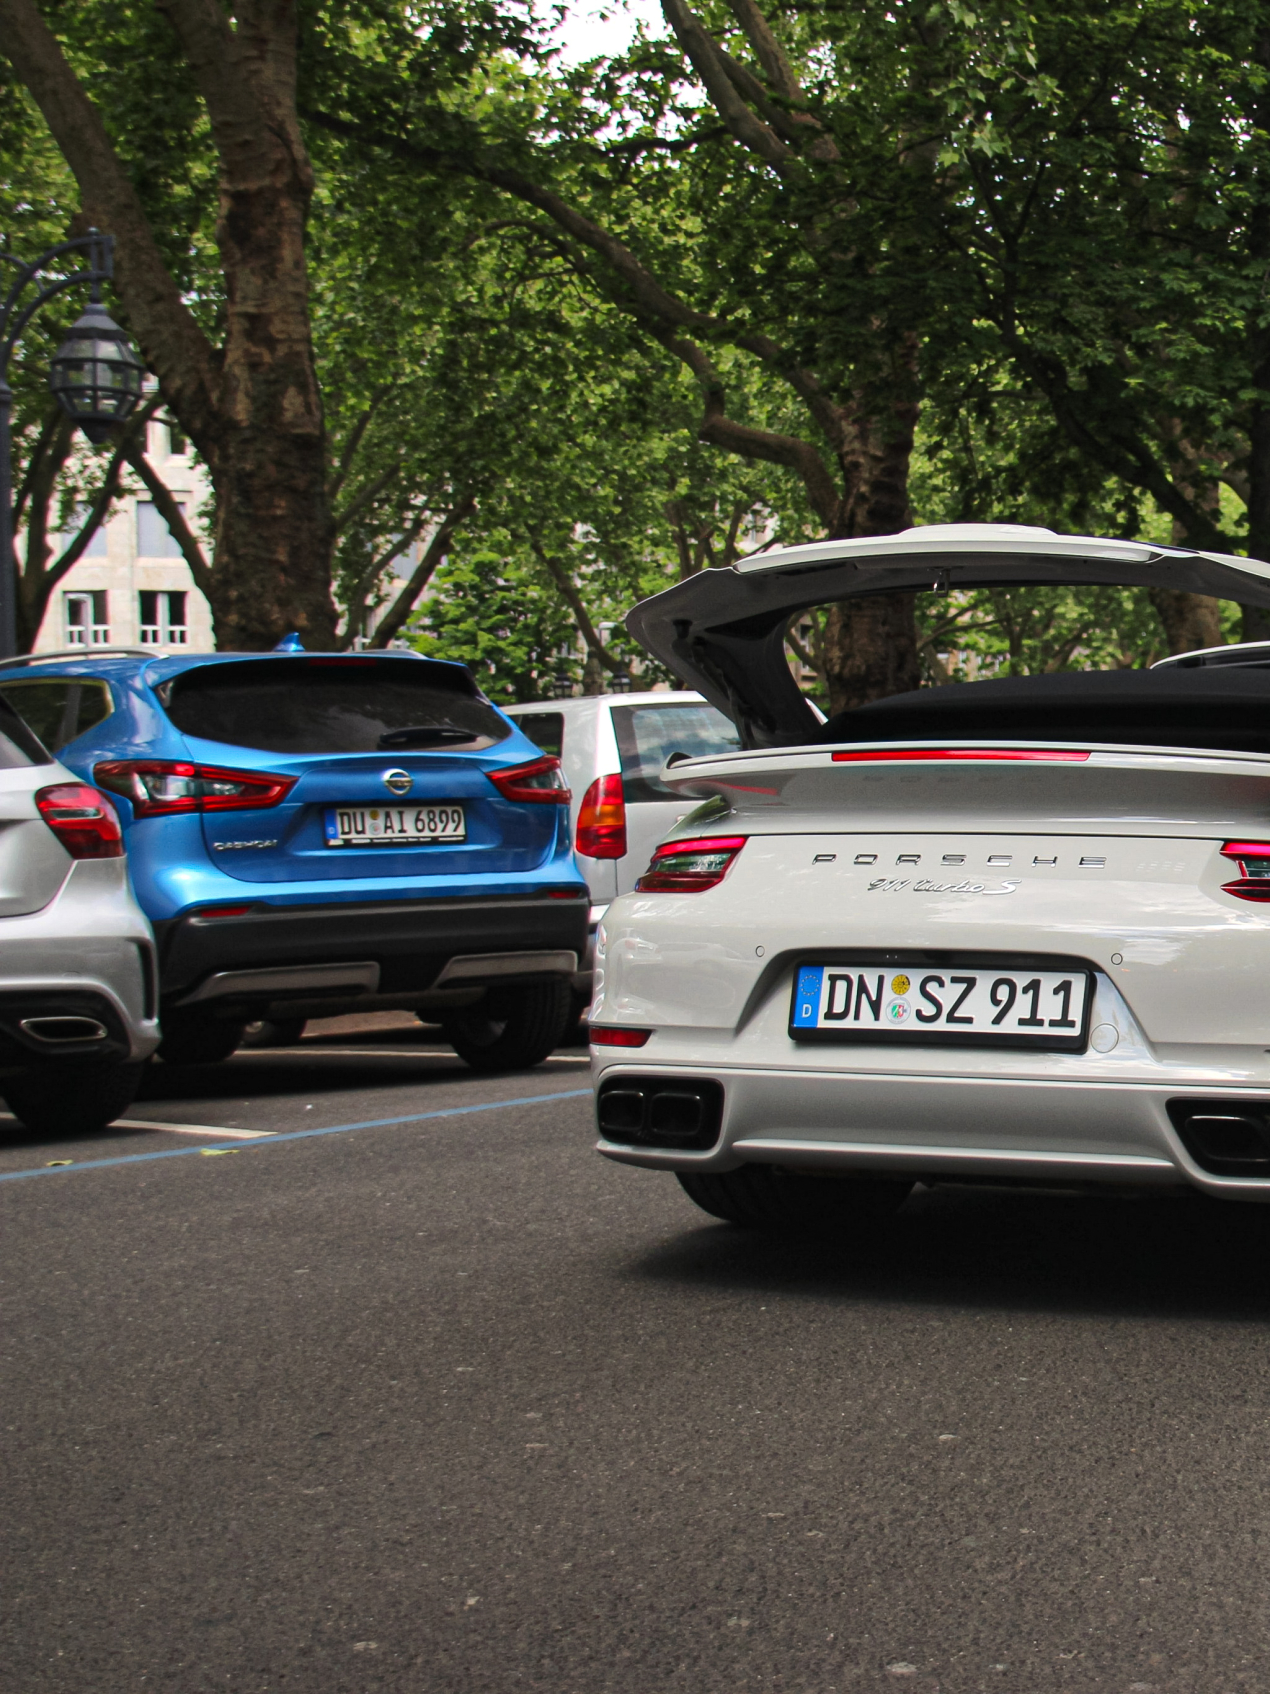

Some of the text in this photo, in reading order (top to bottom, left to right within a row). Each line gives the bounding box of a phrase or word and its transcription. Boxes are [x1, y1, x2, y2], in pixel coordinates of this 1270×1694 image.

[339, 809, 463, 836] DU AI 6899
[812, 853, 1107, 869] PORSCHE
[868, 878, 911, 892] 911
[982, 879, 1022, 896] S
[823, 973, 1077, 1029] DN SZ 911
[802, 1003, 812, 1018] D
